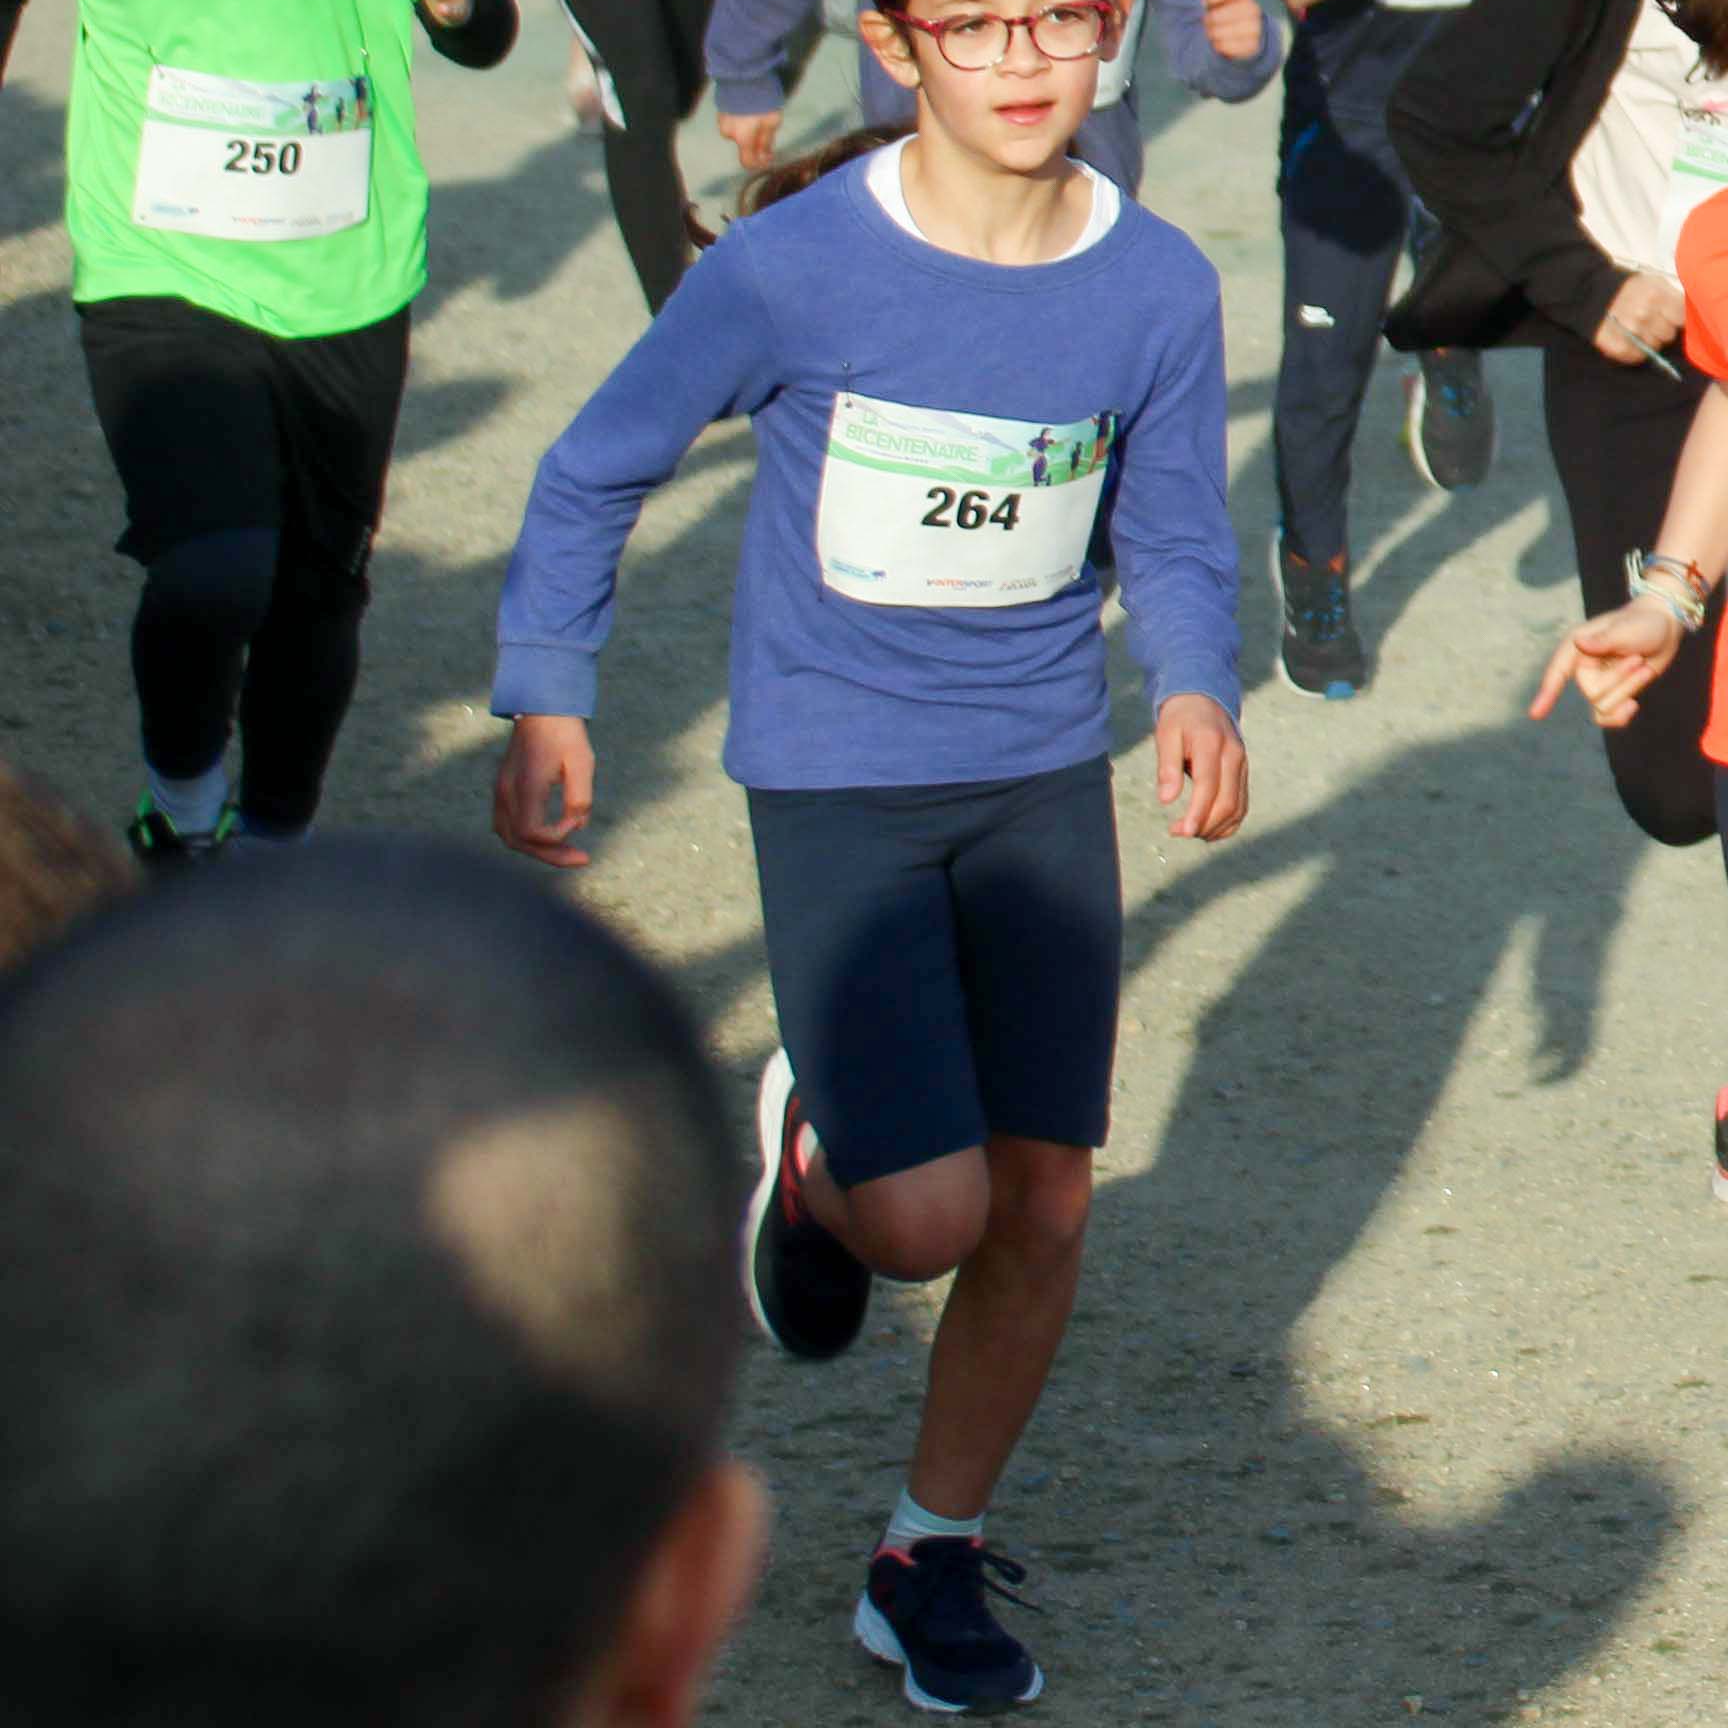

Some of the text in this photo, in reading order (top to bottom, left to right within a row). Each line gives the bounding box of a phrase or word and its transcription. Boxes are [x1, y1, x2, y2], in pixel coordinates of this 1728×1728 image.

[224, 139, 303, 175] 250
[846, 425, 979, 463] BICENTENAIRE
[921, 485, 1022, 531] 264
